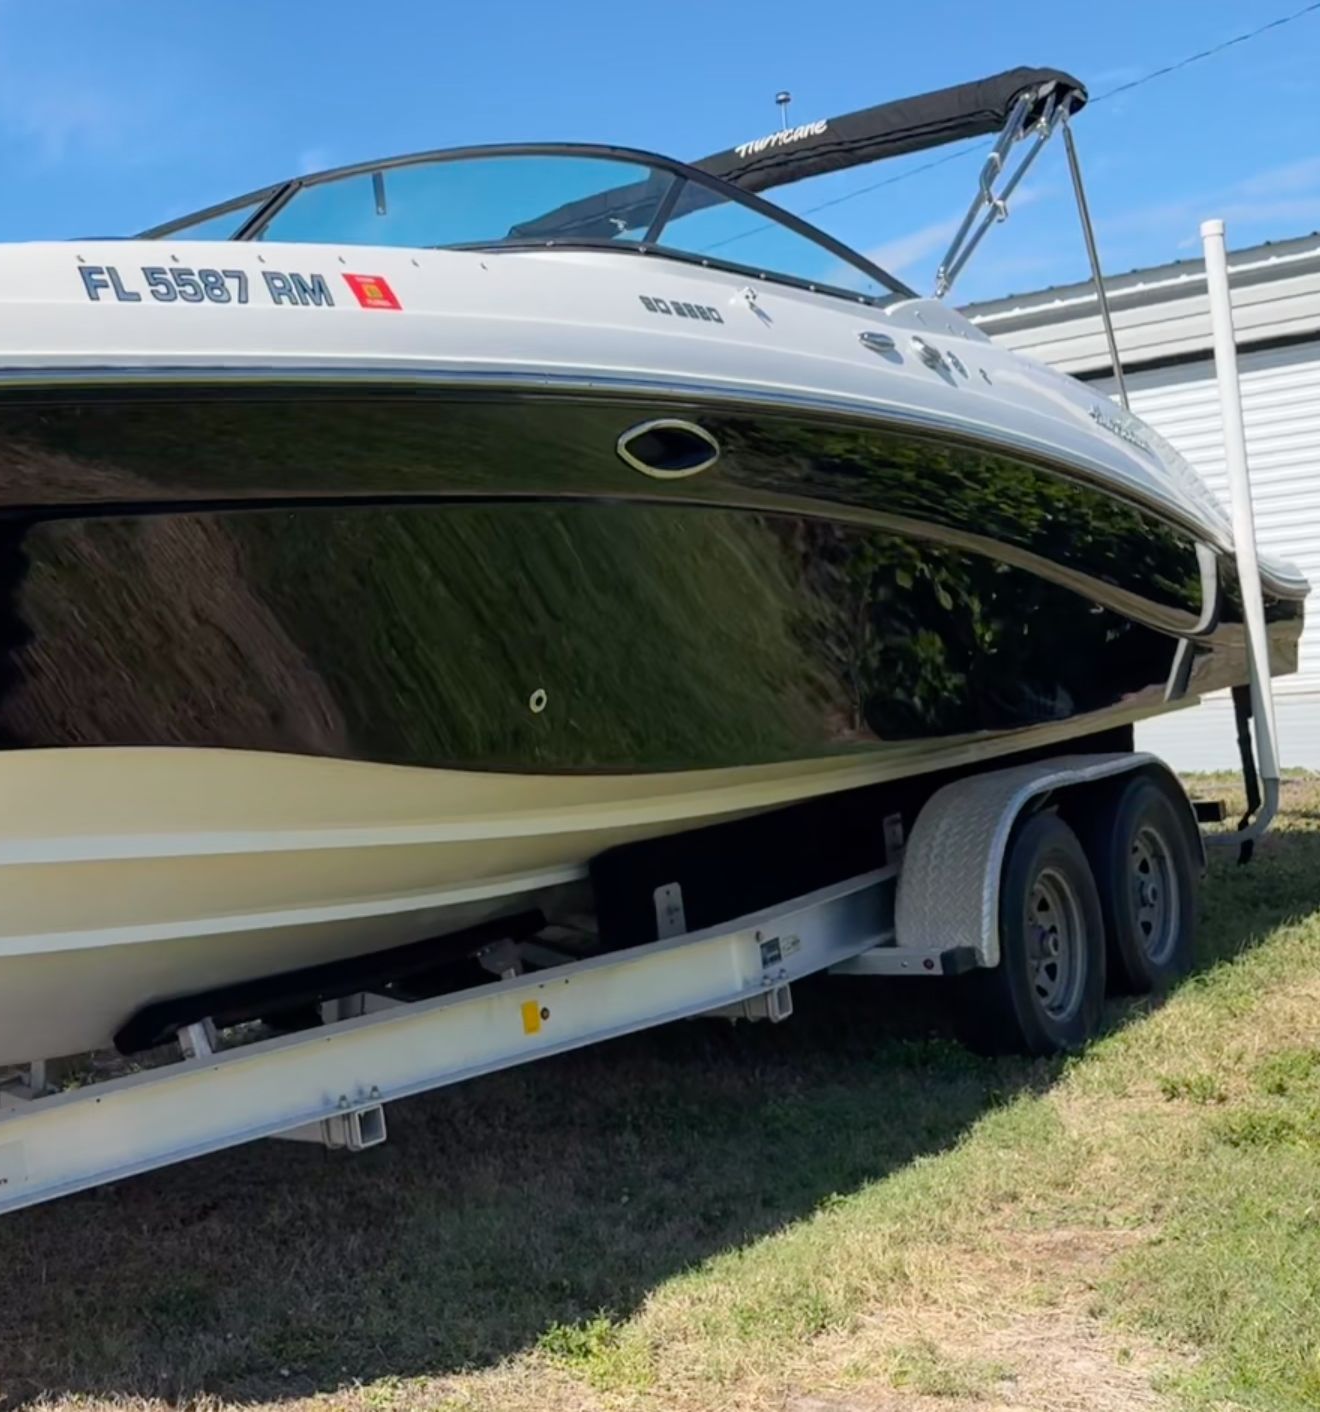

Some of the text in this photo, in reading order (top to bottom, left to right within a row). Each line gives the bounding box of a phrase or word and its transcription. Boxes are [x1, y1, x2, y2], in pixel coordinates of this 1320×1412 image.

[78, 266, 142, 301] FL
[141, 266, 249, 304] 5587
[261, 270, 335, 306] RM
